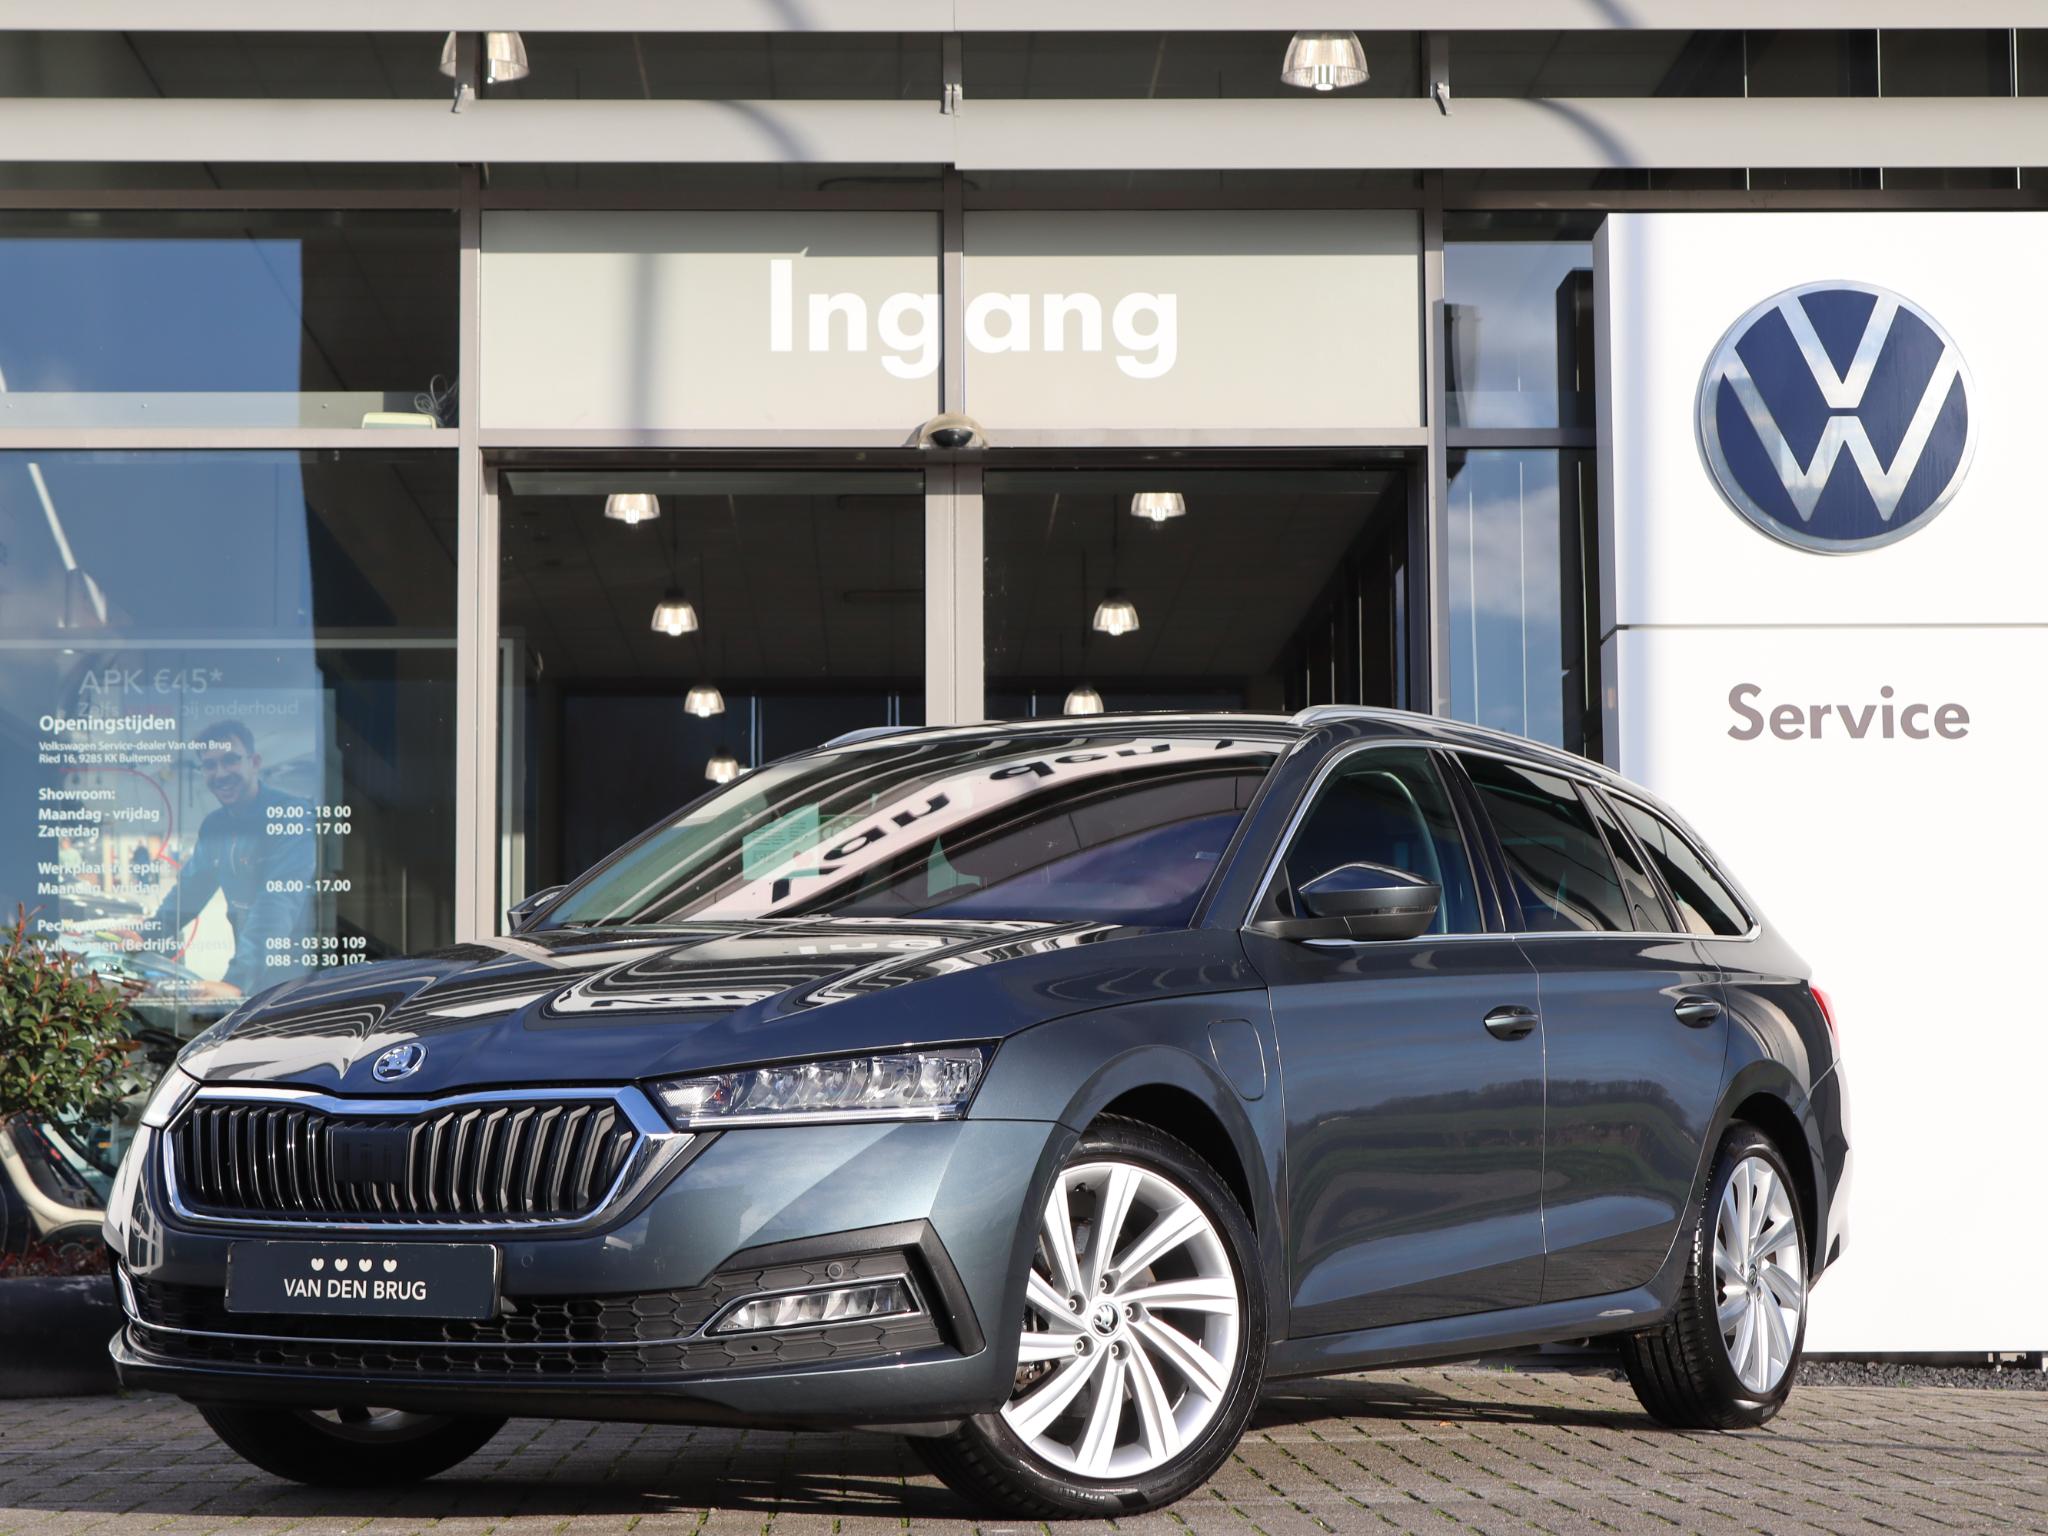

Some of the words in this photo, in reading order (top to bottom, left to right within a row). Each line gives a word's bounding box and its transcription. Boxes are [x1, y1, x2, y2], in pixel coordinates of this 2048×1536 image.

[770, 258, 1178, 379] Ingang
[79, 669, 144, 695] APK
[204, 700, 299, 715] onderhoud
[1727, 682, 1970, 741] Service
[39, 713, 176, 734] Openingstijden
[39, 740, 97, 752] Volkswagen
[98, 740, 167, 751] Service-dealer
[168, 740, 186, 750] Van
[187, 740, 207, 750] den
[208, 740, 232, 752] Brug
[39, 754, 60, 764] Ried
[79, 753, 102, 764] 9285
[104, 754, 117, 764] KK
[119, 753, 172, 766] Buitenpost
[38, 787, 116, 801] Showroom:
[38, 807, 102, 823] Maandag
[113, 807, 160, 823] vrijdag
[266, 805, 304, 819] 09.00
[38, 824, 100, 840] Zaterdag
[266, 822, 304, 835] 09.00
[38, 861, 170, 877] Werkplaatrceptie:
[266, 879, 304, 892] 08.00
[315, 879, 352, 892] 17.00
[37, 919, 162, 934] Pechmmer:
[265, 937, 292, 950] 088
[301, 937, 319, 950] 03
[321, 937, 339, 949] 30
[342, 936, 367, 949] 109
[265, 954, 292, 967] 088
[301, 954, 319, 966] 03
[321, 953, 339, 966] 30
[342, 953, 367, 965] 107
[284, 1278, 323, 1298] VAN
[327, 1279, 367, 1299] DEN
[373, 1280, 427, 1301] BRUG
